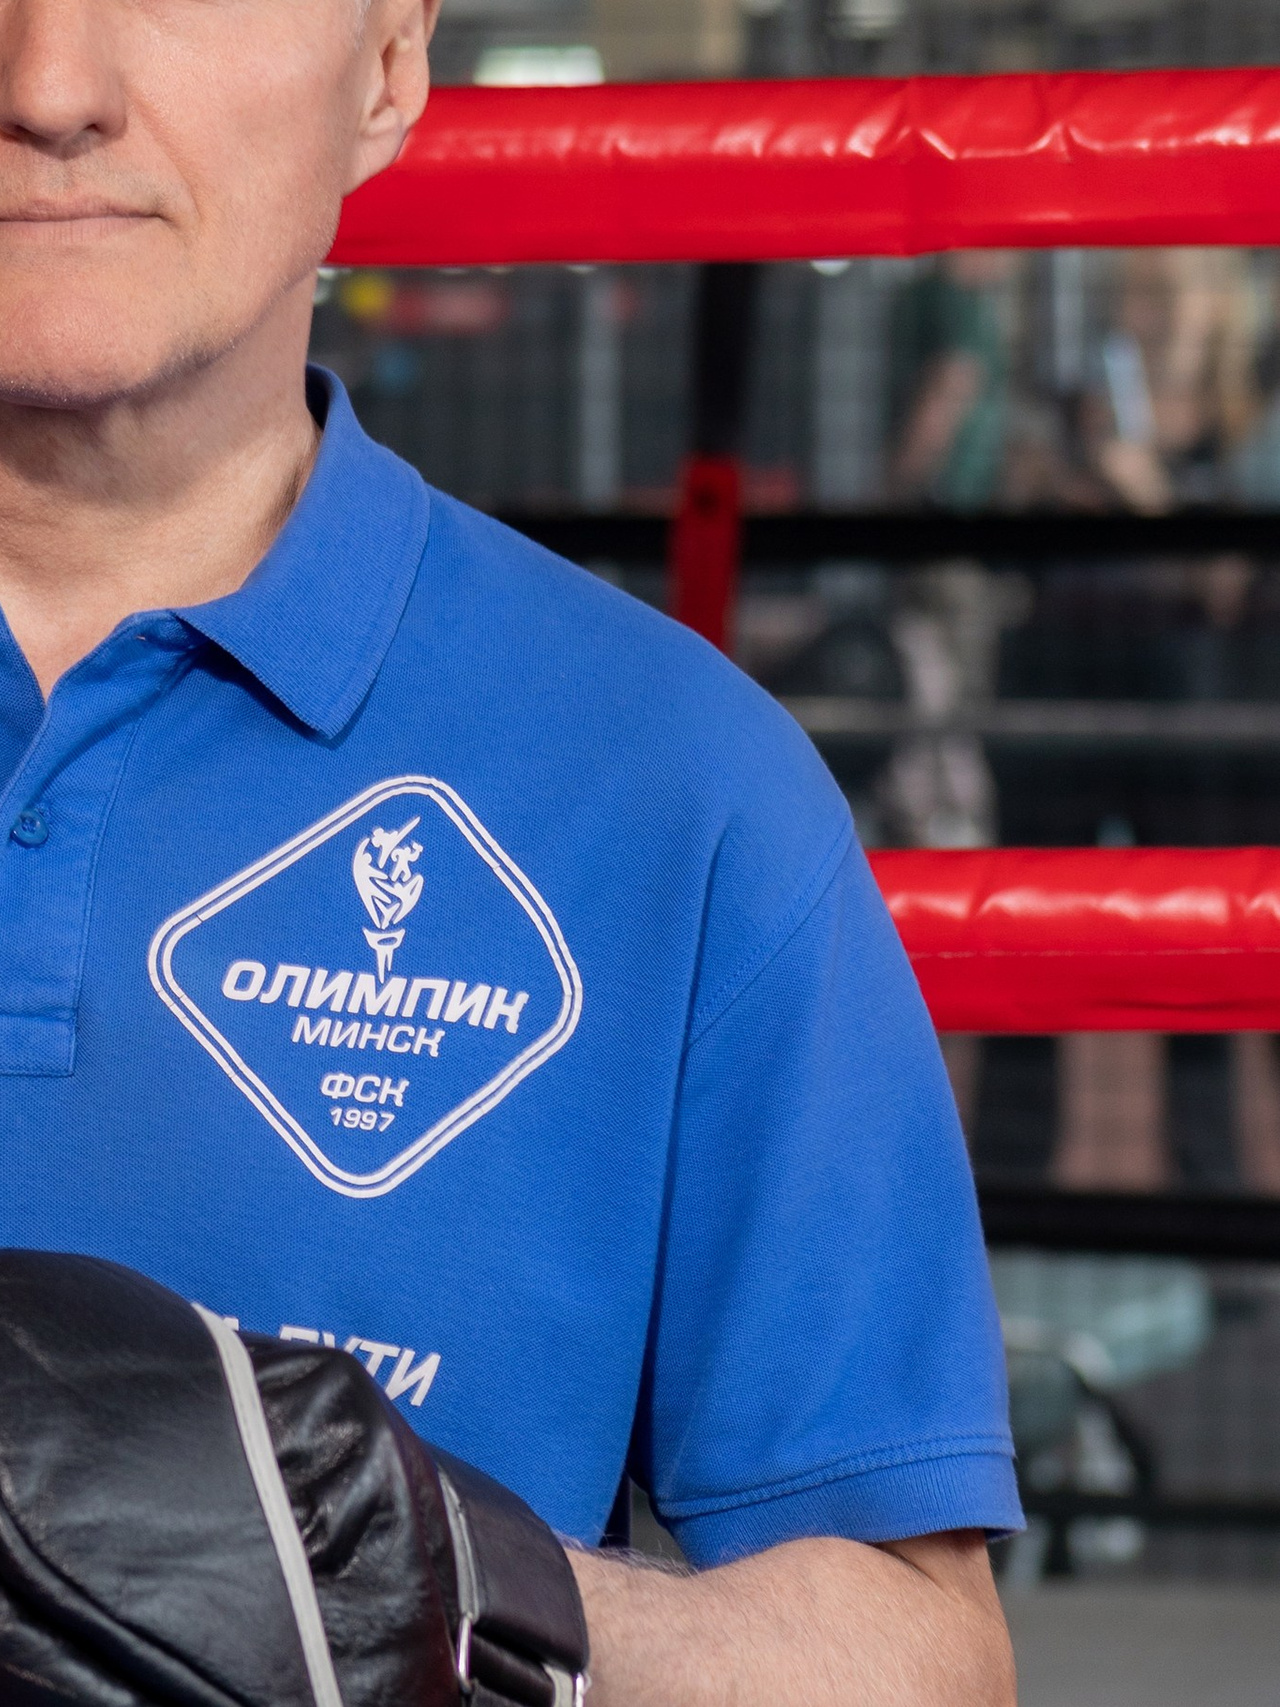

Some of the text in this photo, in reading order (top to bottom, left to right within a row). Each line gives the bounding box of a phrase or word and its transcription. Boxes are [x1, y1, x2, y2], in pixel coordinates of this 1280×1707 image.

[221, 960, 530, 1034] ОЛИМПИК
[291, 1015, 446, 1058] МИНСК
[320, 1072, 410, 1107] ФСК
[329, 1107, 396, 1132] 1997
